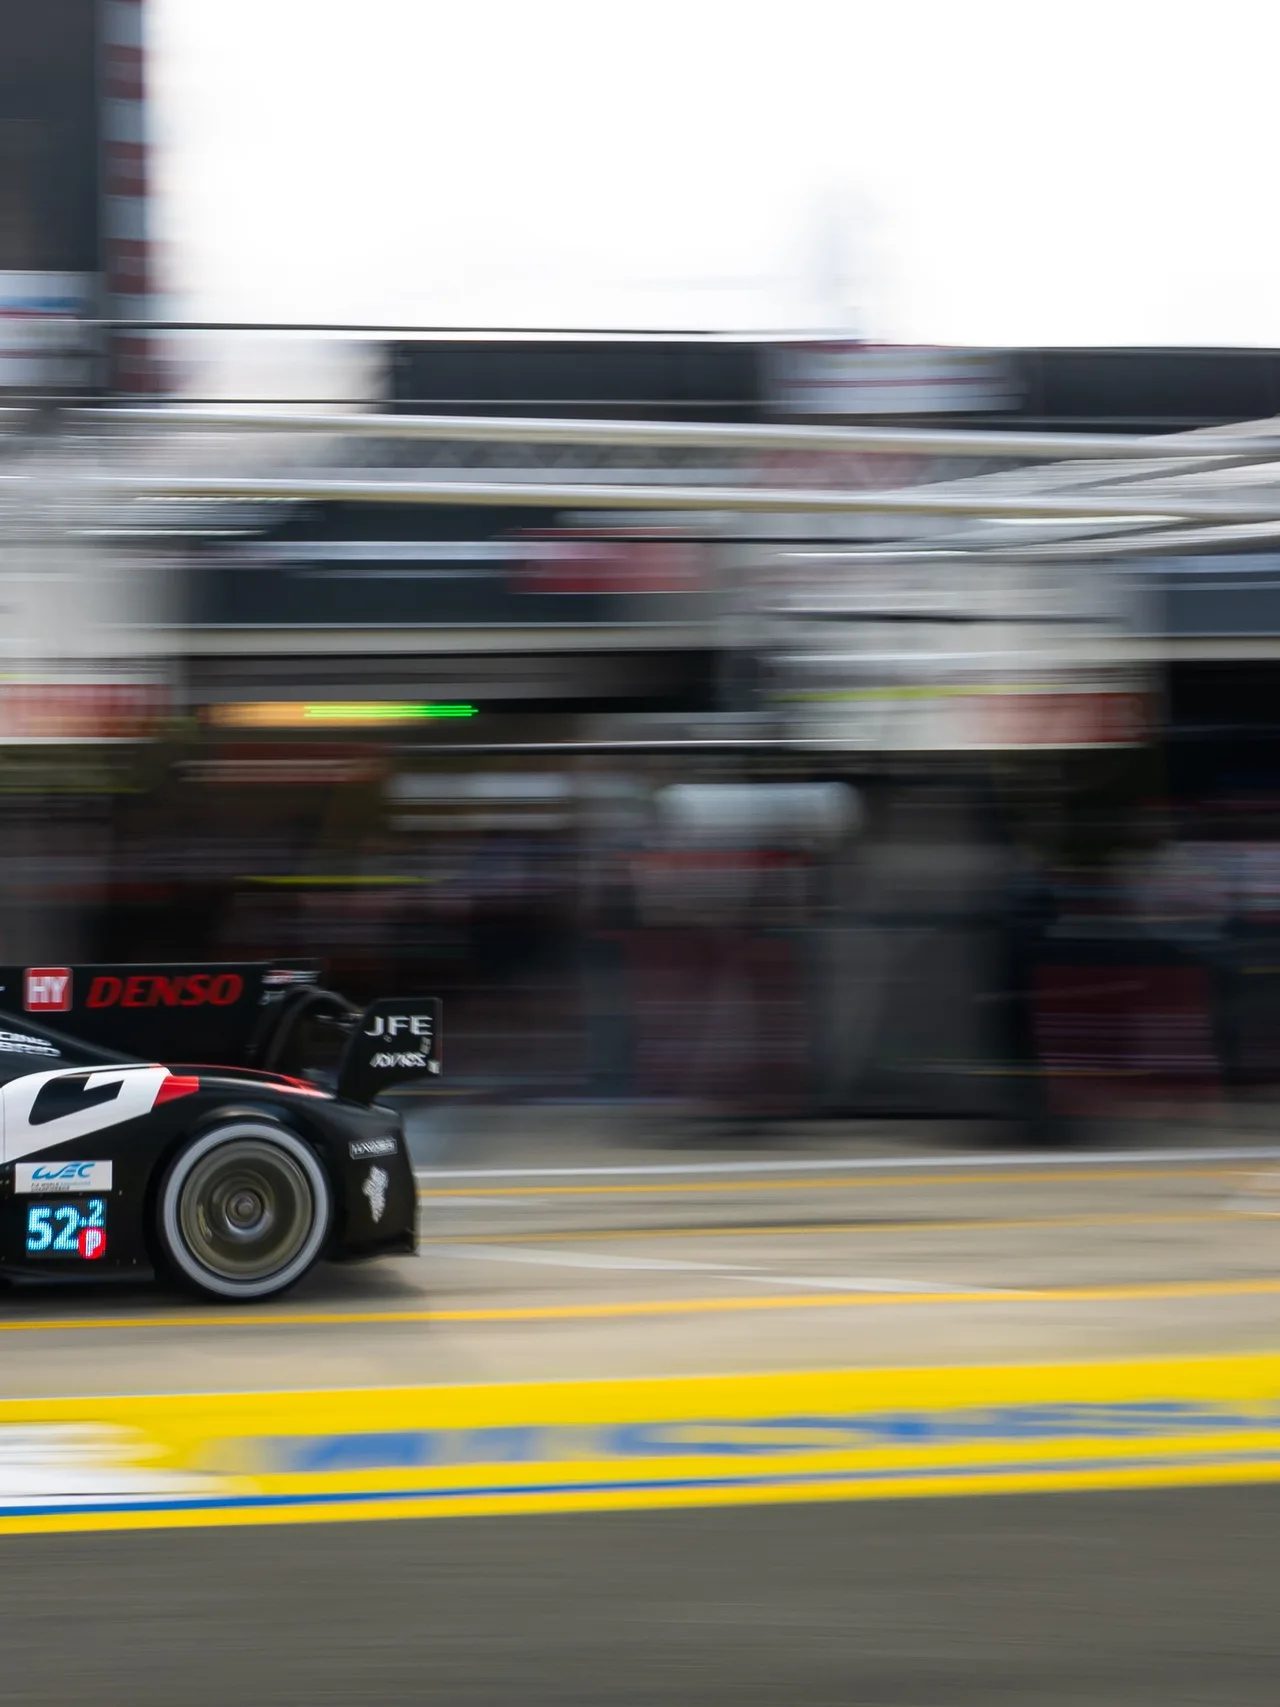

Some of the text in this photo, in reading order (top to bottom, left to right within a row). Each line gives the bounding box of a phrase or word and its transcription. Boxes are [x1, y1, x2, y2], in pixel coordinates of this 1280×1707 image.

[28, 976, 69, 1003] HY
[86, 974, 243, 1008] DENSO
[364, 1015, 433, 1037] JFE
[31, 1162, 96, 1180] WEC
[85, 1229, 103, 1257] P
